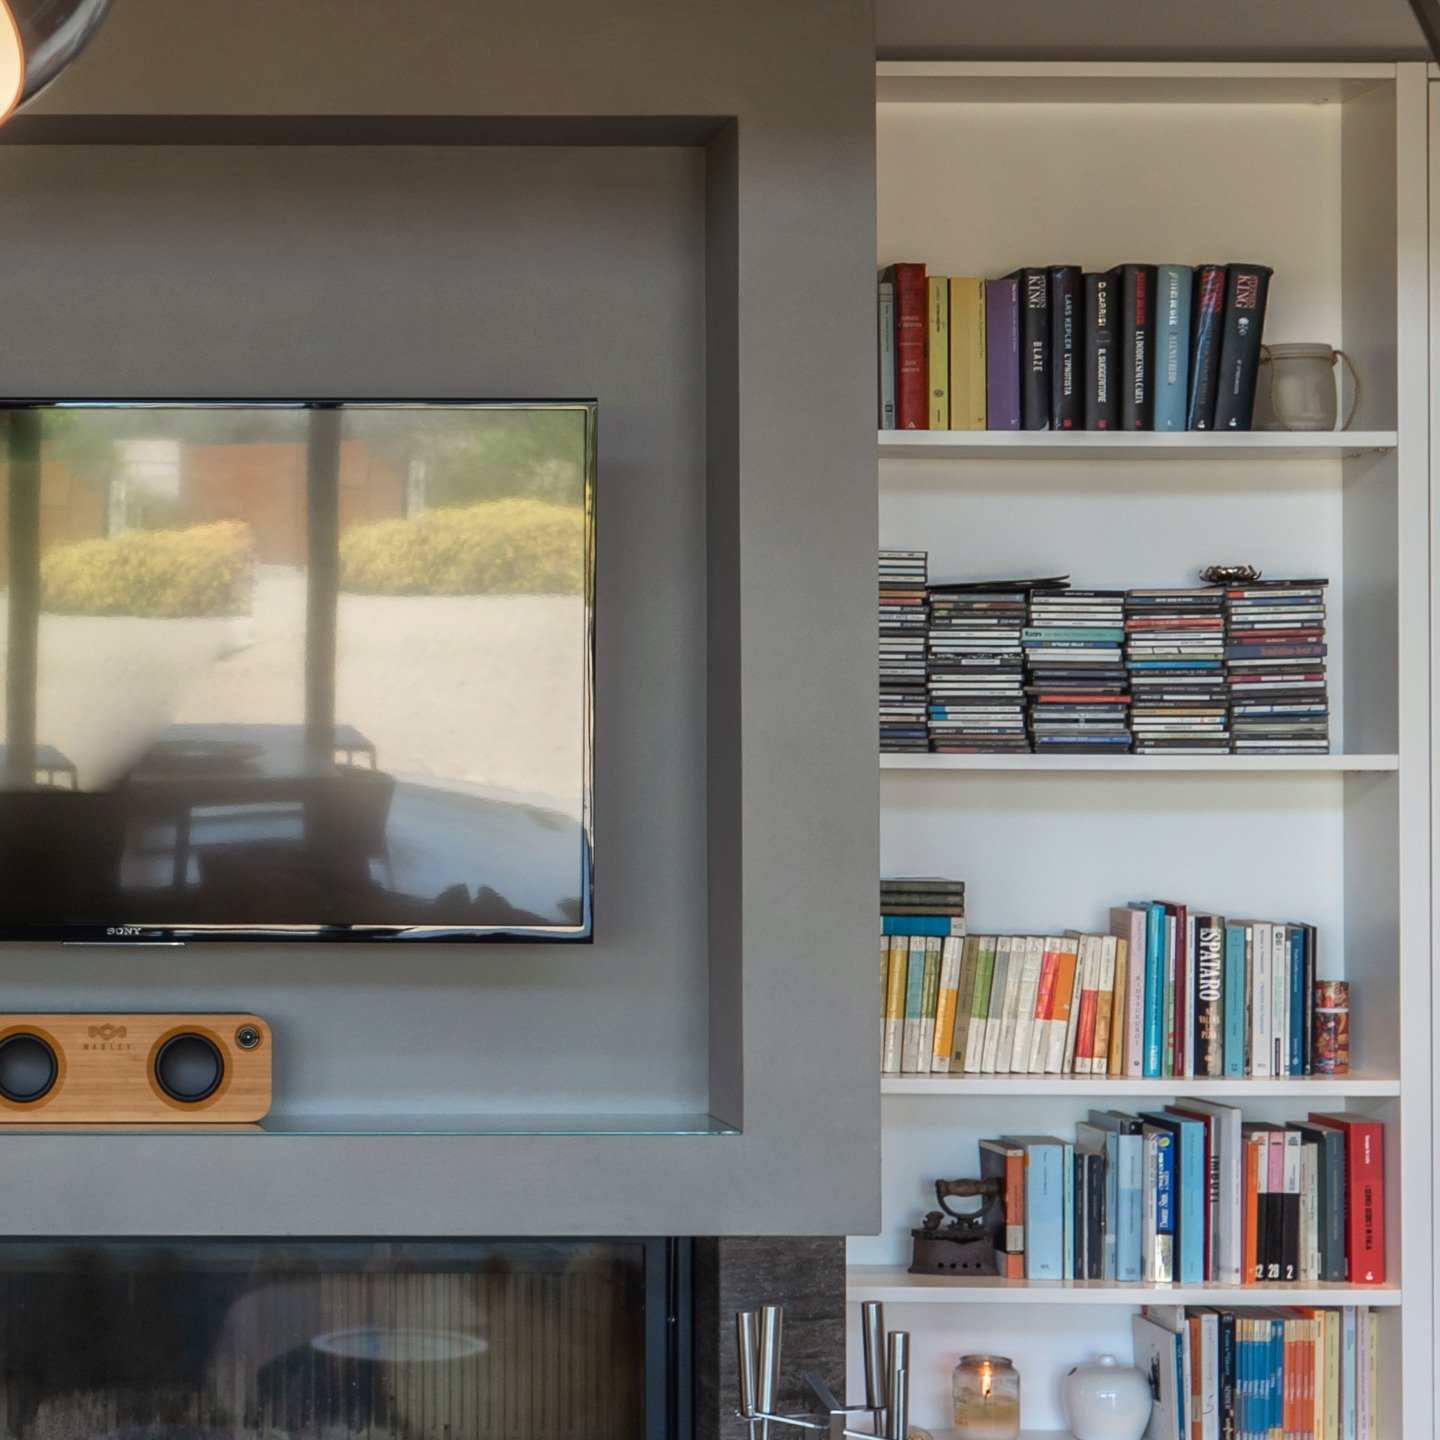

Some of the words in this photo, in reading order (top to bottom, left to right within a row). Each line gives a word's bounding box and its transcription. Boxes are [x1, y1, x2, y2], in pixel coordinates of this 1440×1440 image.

[1029, 275, 1041, 308] KING
[1064, 294, 1072, 315] LARS
[1235, 274, 1251, 309] KING
[1064, 318, 1072, 349] KEPLER
[1033, 341, 1043, 372] BLAZE
[106, 927, 142, 936] SONY
[1199, 930, 1221, 1002] SPATARO
[1286, 1264, 1293, 1279] 2
